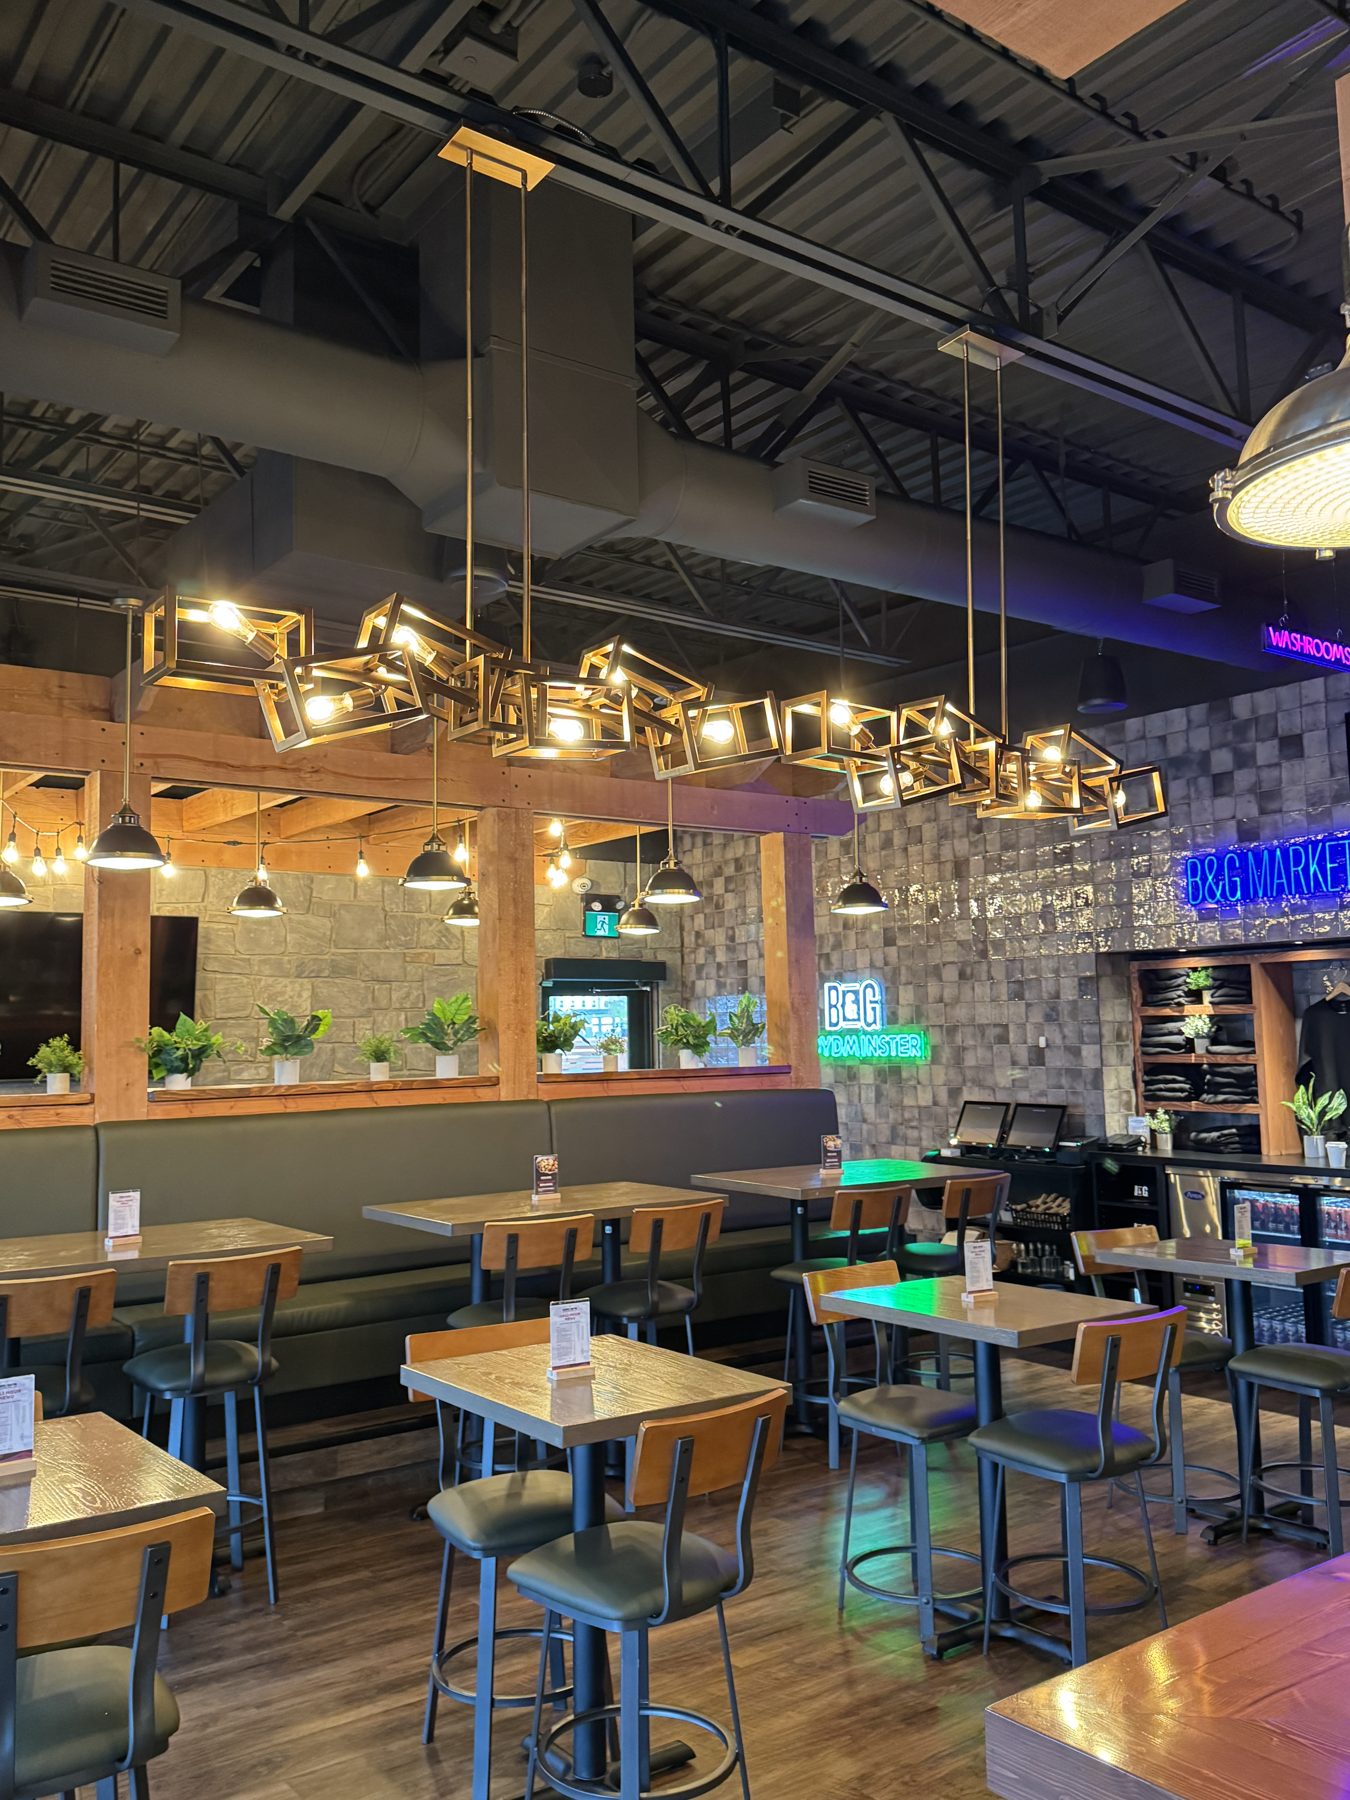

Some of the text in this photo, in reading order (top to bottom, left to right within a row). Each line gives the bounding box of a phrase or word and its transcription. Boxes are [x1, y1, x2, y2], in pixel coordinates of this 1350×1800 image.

[1268, 626, 1350, 666] WASHROOMS
[1187, 839, 1350, 905] B&G MARKET
[824, 979, 881, 1031] B&G
